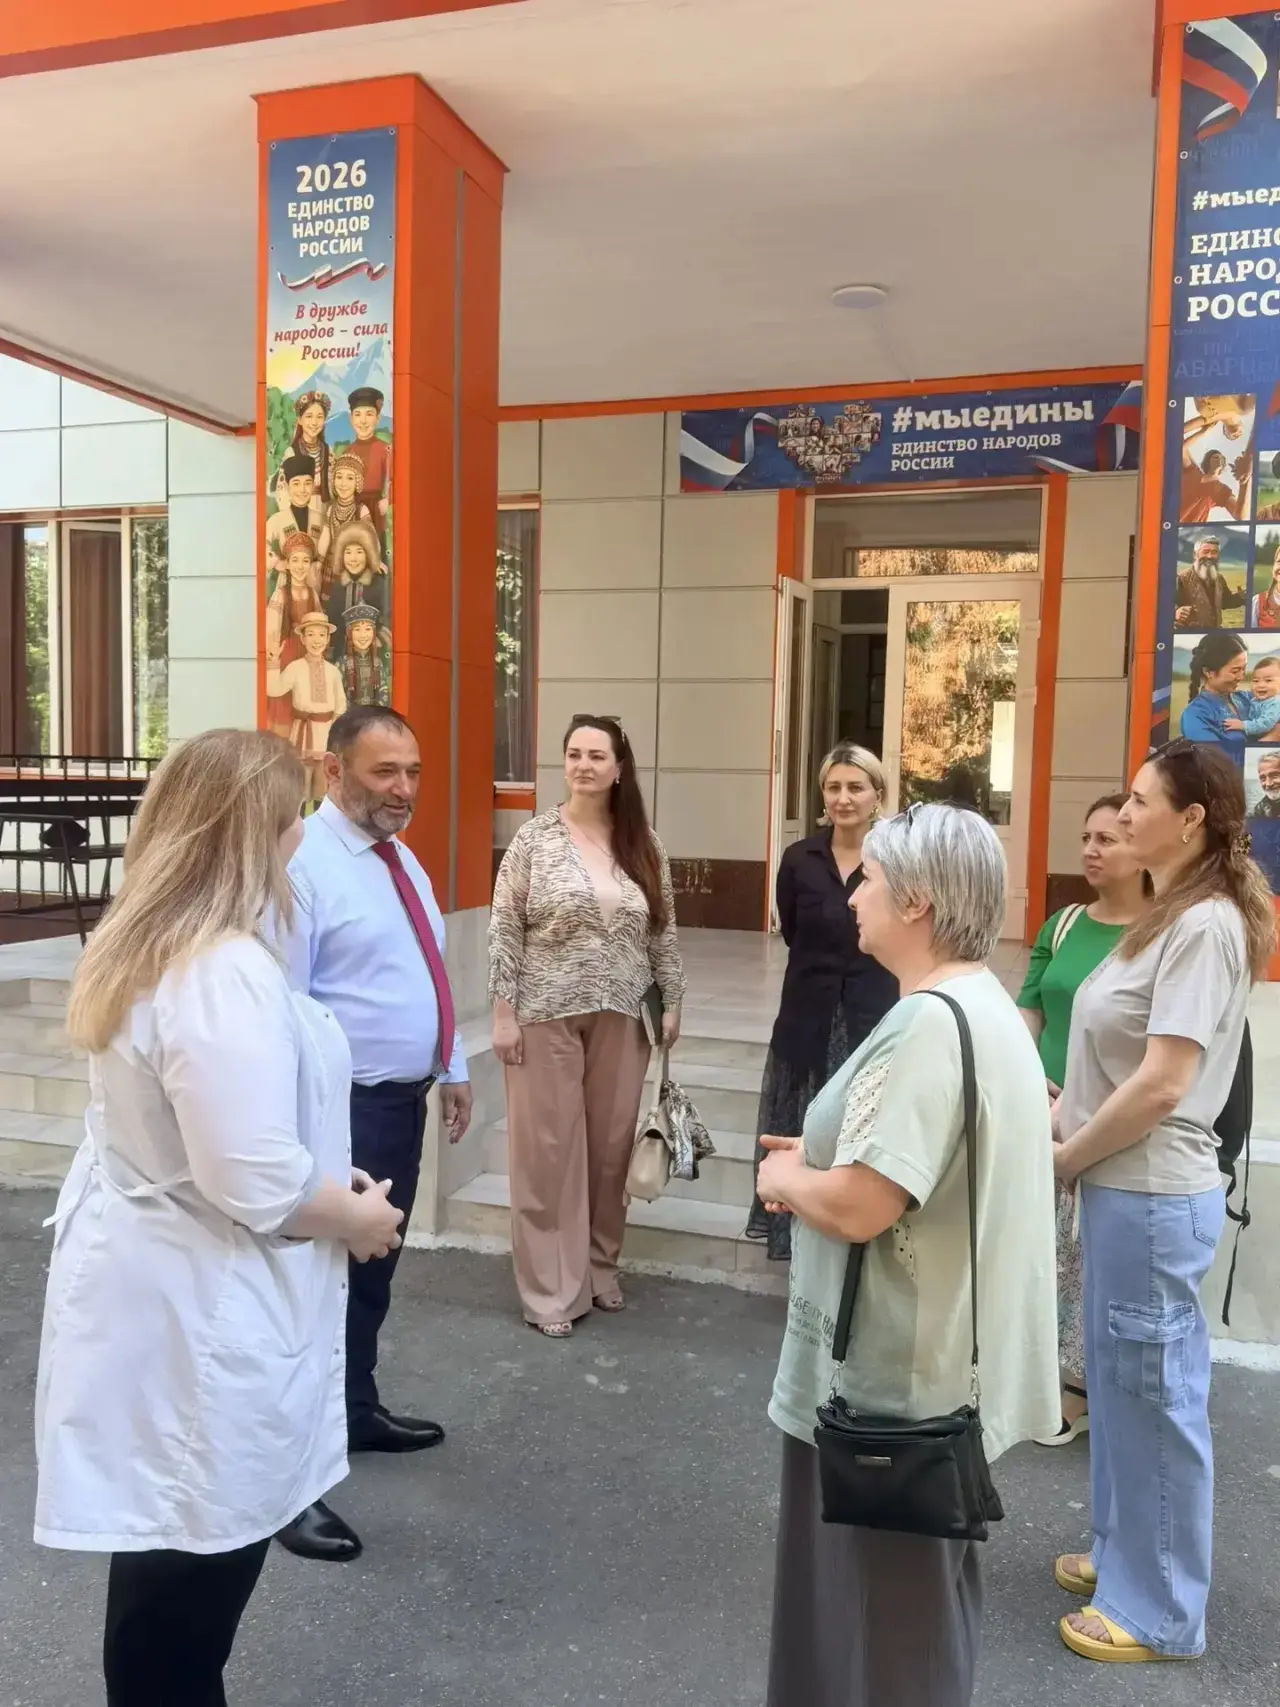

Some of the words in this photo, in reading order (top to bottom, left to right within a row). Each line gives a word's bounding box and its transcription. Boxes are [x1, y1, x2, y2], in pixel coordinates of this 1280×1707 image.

[296, 159, 367, 193] 2026
[287, 194, 374, 221] ЕДИНСТВО
[292, 215, 370, 239] НАРОДОВ
[299, 236, 363, 258] РОССИИ
[1189, 257, 1280, 286] НАРО
[295, 304, 306, 319] В
[309, 300, 367, 322] дружбе
[274, 325, 334, 346] народов
[353, 321, 388, 337] сила
[301, 342, 360, 360] России!
[892, 399, 1095, 433] #мыедины
[891, 436, 978, 458] ЕДИНСТВО
[982, 432, 1063, 452] НАРОДОВ
[890, 456, 955, 472] РОССИИ
